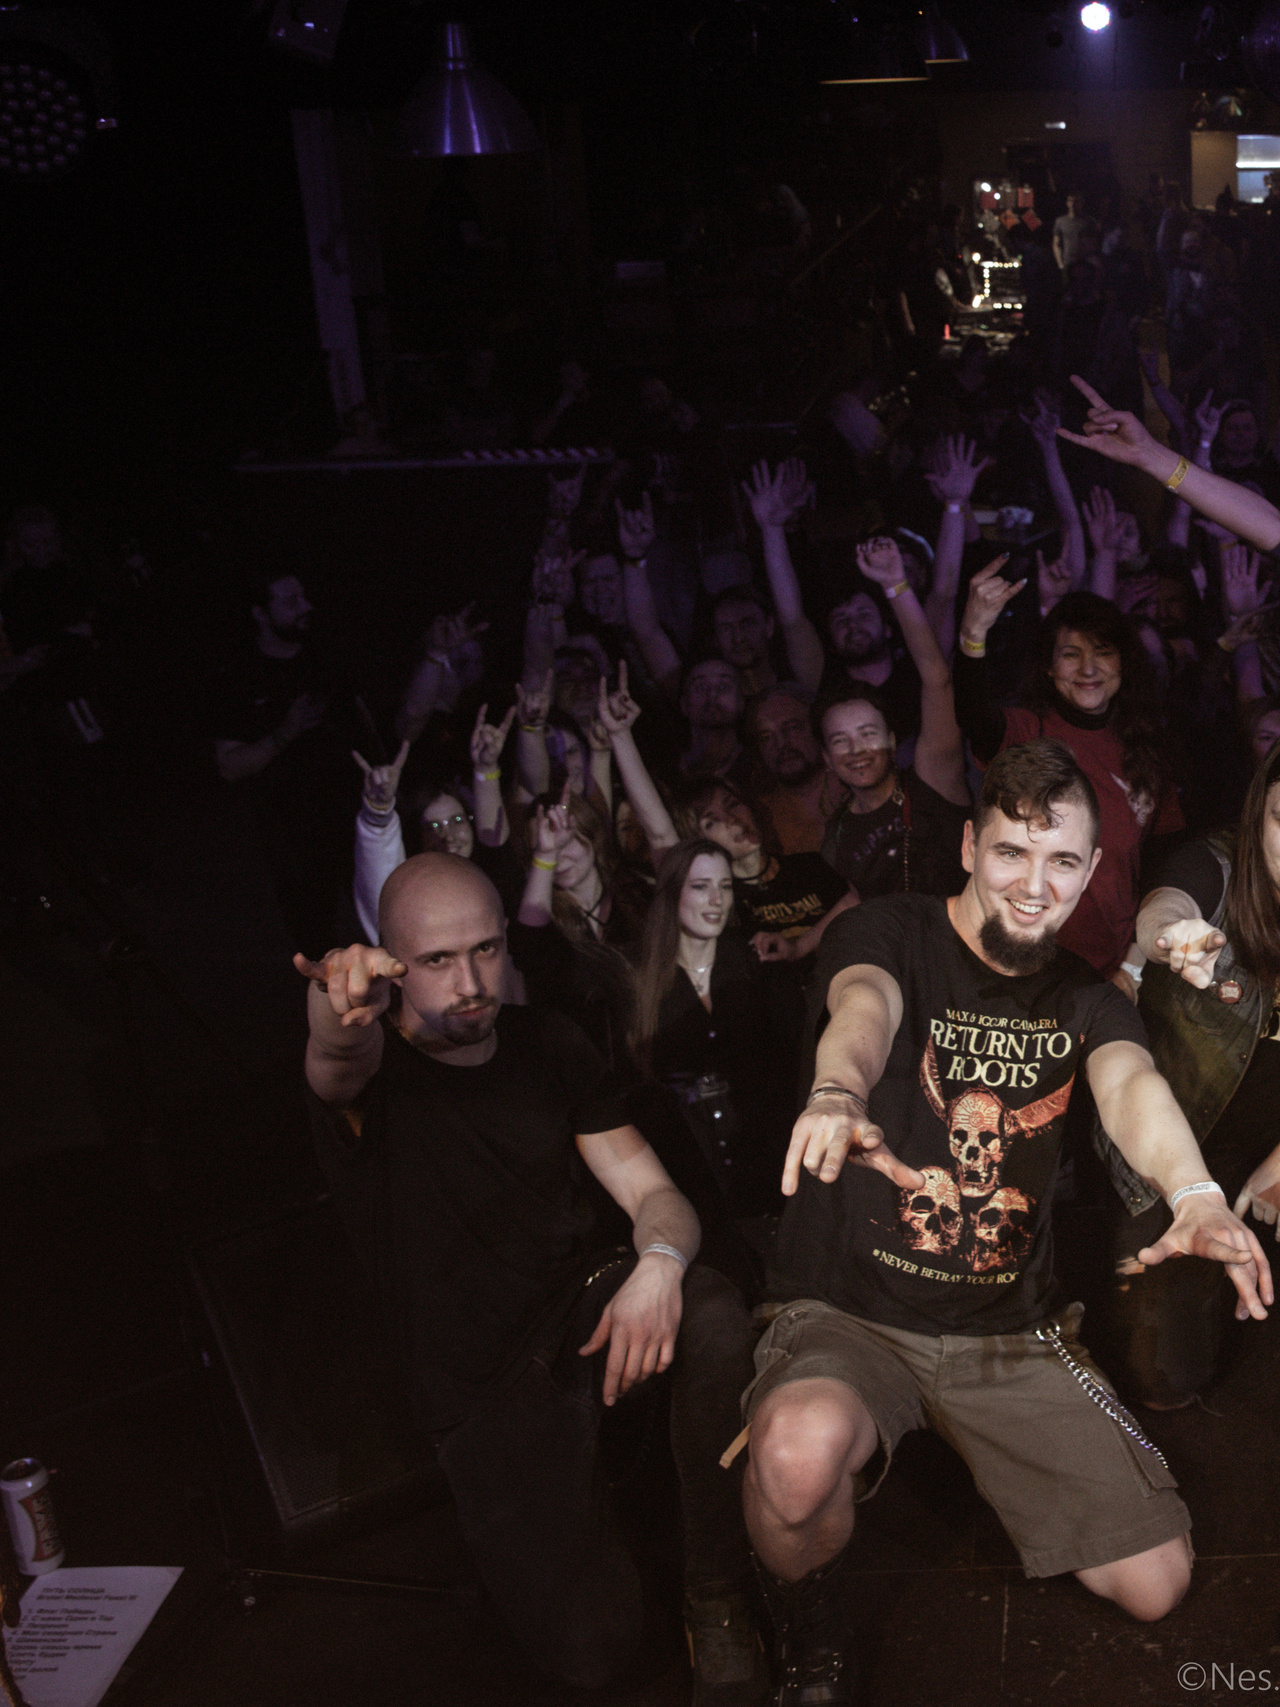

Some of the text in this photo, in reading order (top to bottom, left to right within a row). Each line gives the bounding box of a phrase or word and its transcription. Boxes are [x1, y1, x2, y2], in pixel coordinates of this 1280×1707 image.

[946, 1008, 970, 1022] MAX
[930, 1018, 1072, 1060] RETURN TO
[945, 1055, 1041, 1089] ROOTS
[920, 1267, 964, 1283] BETRAY
[966, 1275, 995, 1286] YOUR
